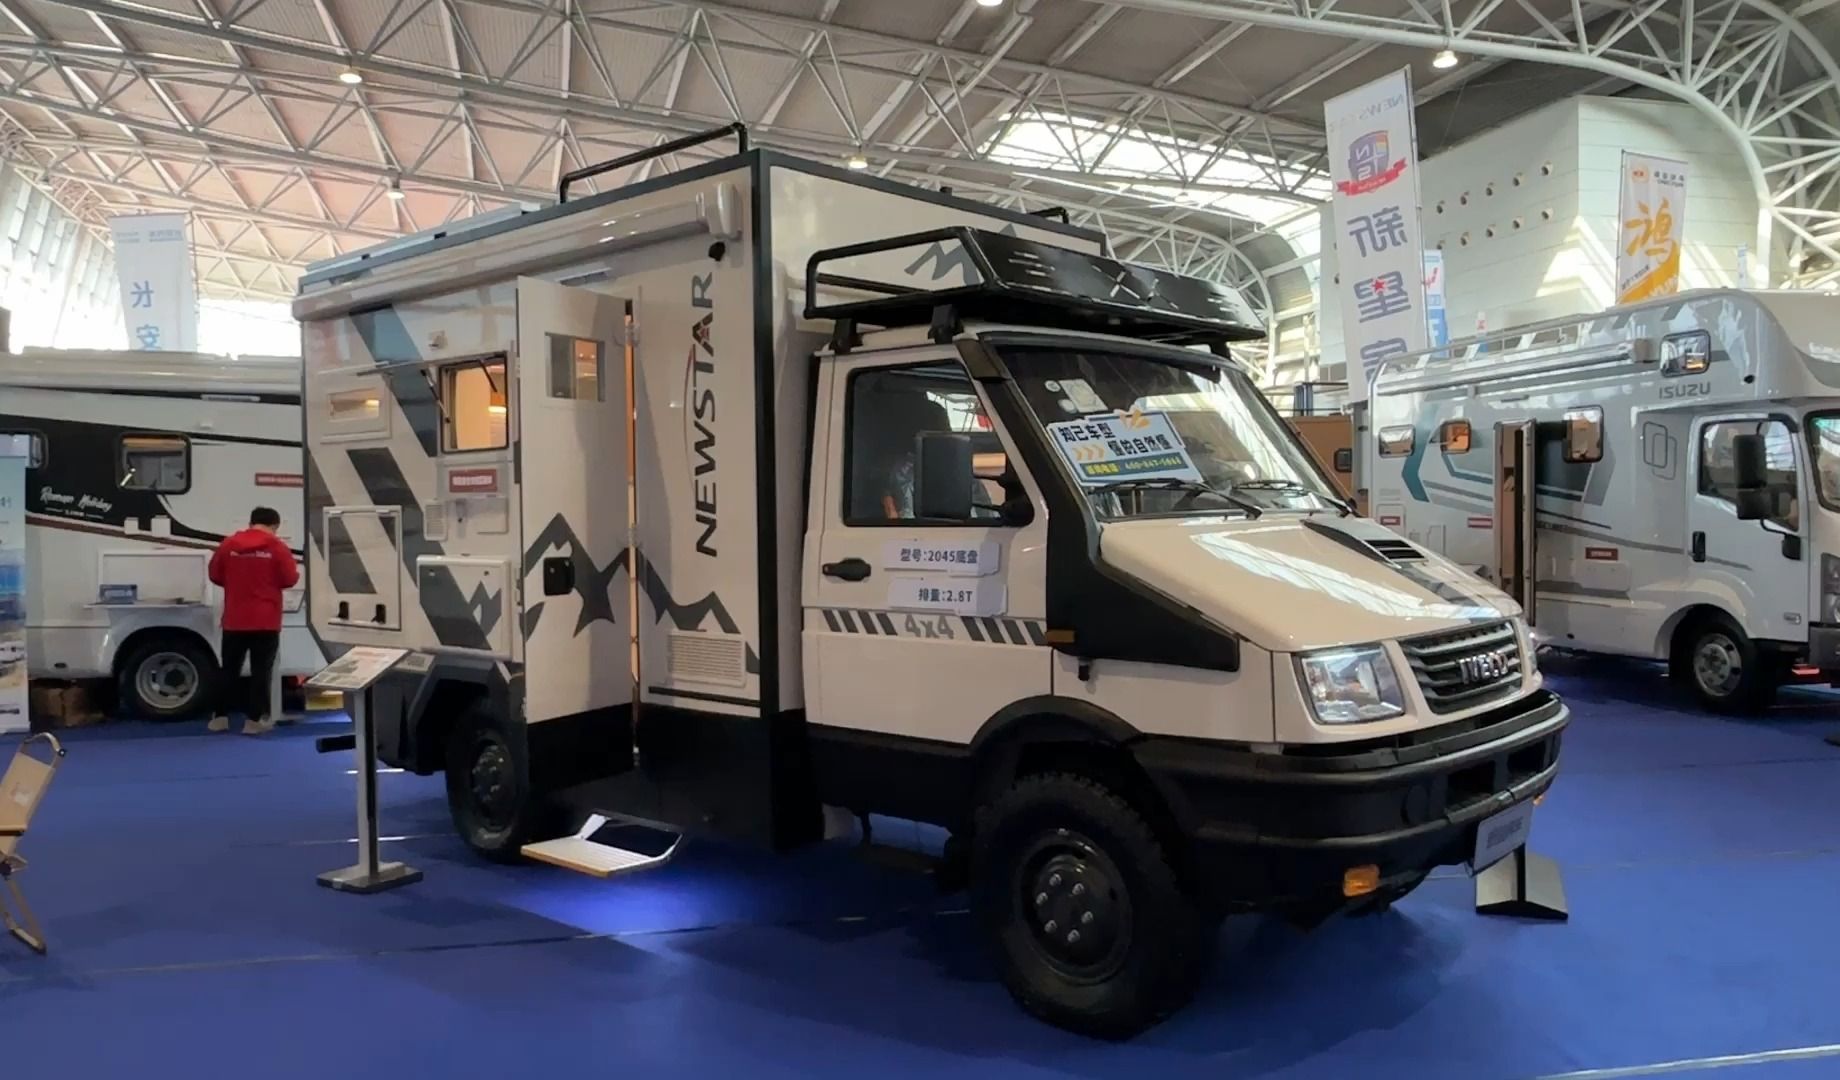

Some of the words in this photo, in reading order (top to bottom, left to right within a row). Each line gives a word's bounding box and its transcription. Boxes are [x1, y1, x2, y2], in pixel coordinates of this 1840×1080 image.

[1659, 381, 1711, 399] ISUZU
[691, 272, 717, 557] NEWSTAR
[1459, 651, 1509, 685] IVECO
